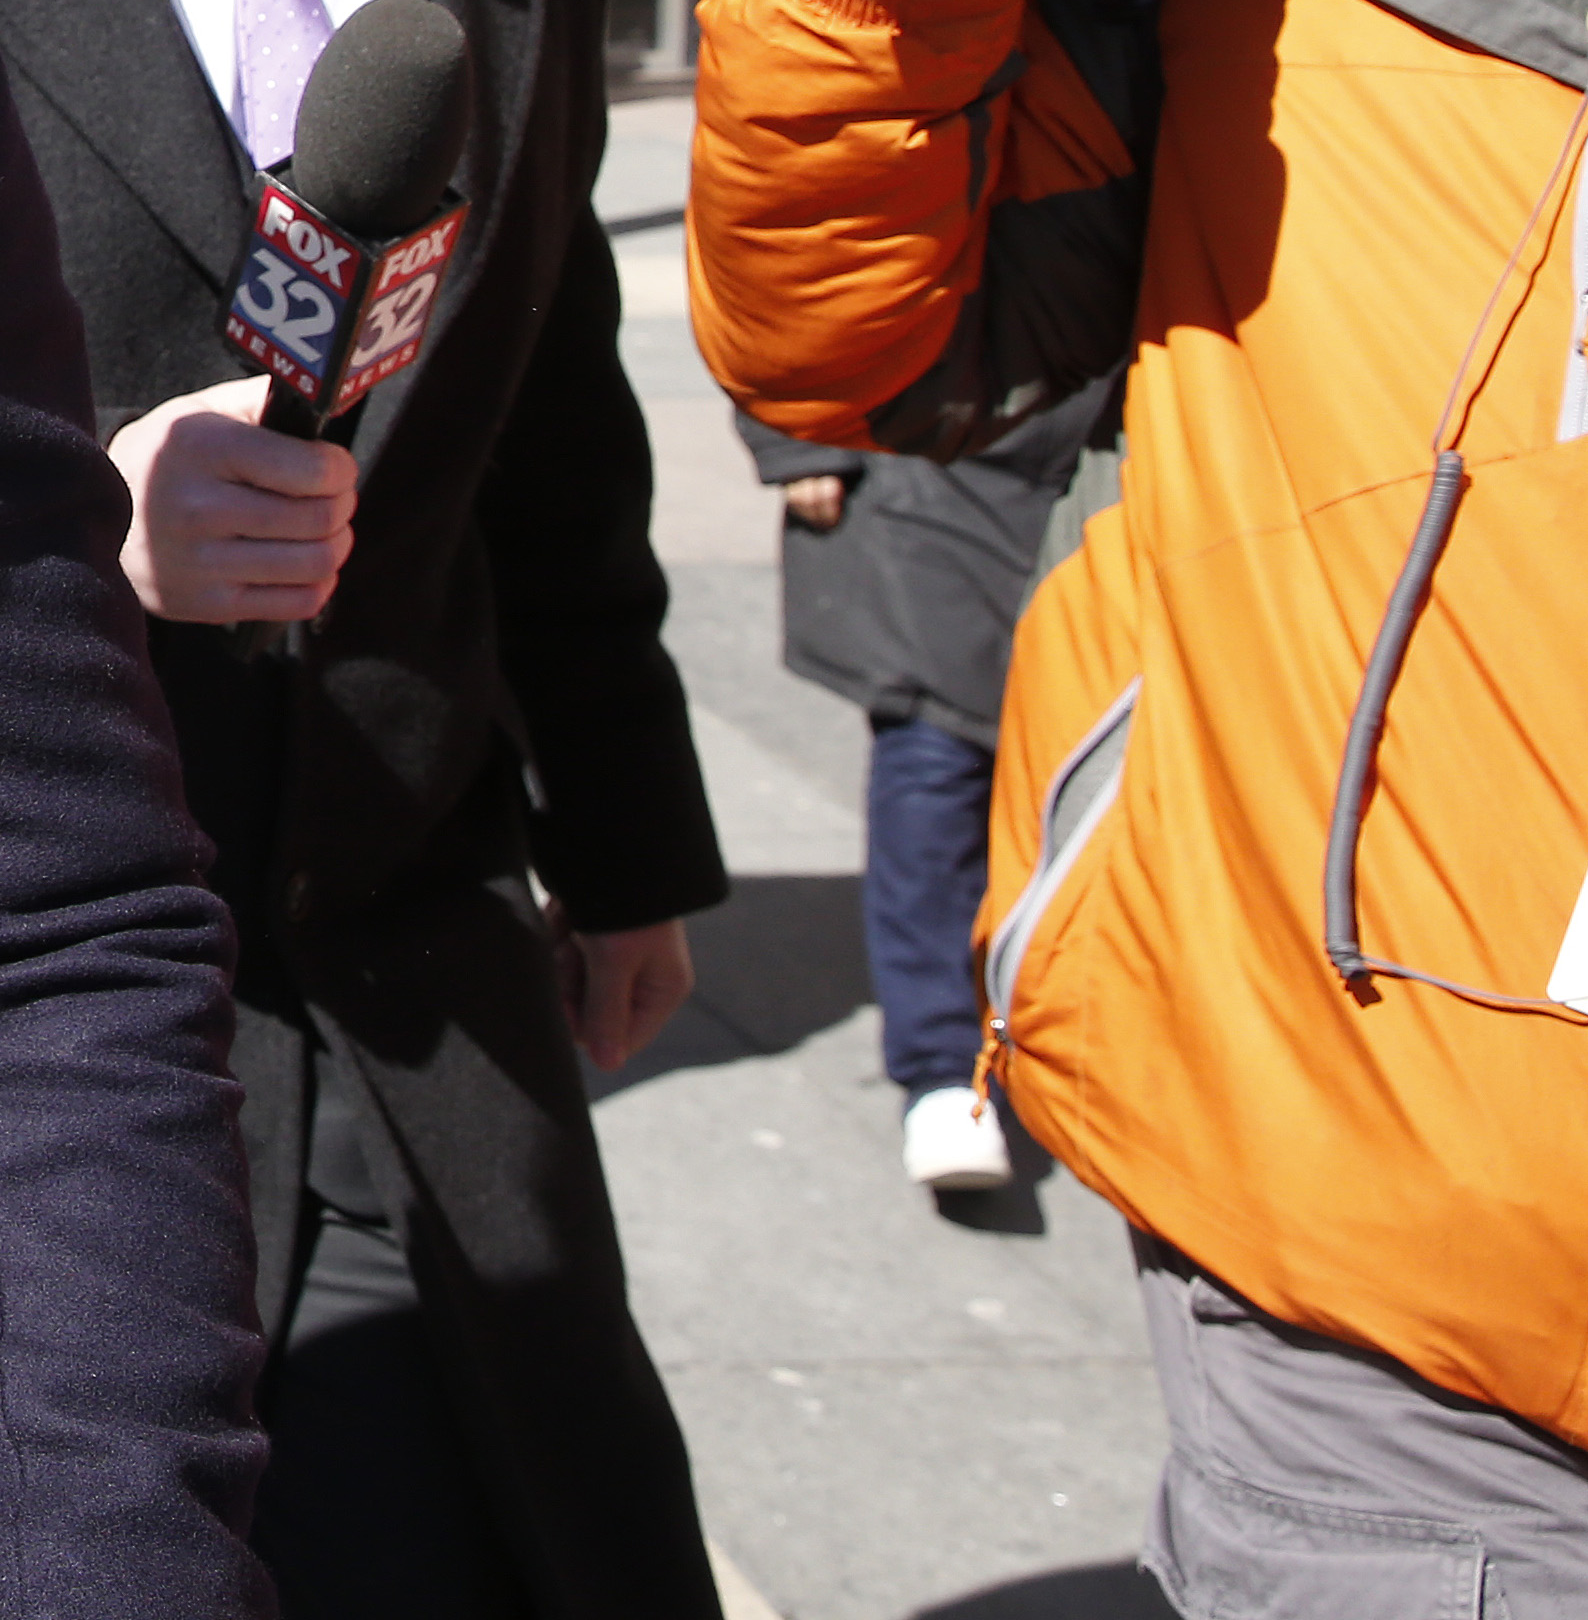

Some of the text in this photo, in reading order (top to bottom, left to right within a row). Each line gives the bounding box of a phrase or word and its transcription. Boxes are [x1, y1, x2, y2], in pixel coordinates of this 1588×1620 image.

[261, 195, 351, 289] FOX
[376, 220, 455, 291] FOX
[236, 247, 336, 364] 32
[350, 272, 437, 367] 32
[226, 316, 315, 395] NEWS
[338, 343, 416, 401] NEWS
